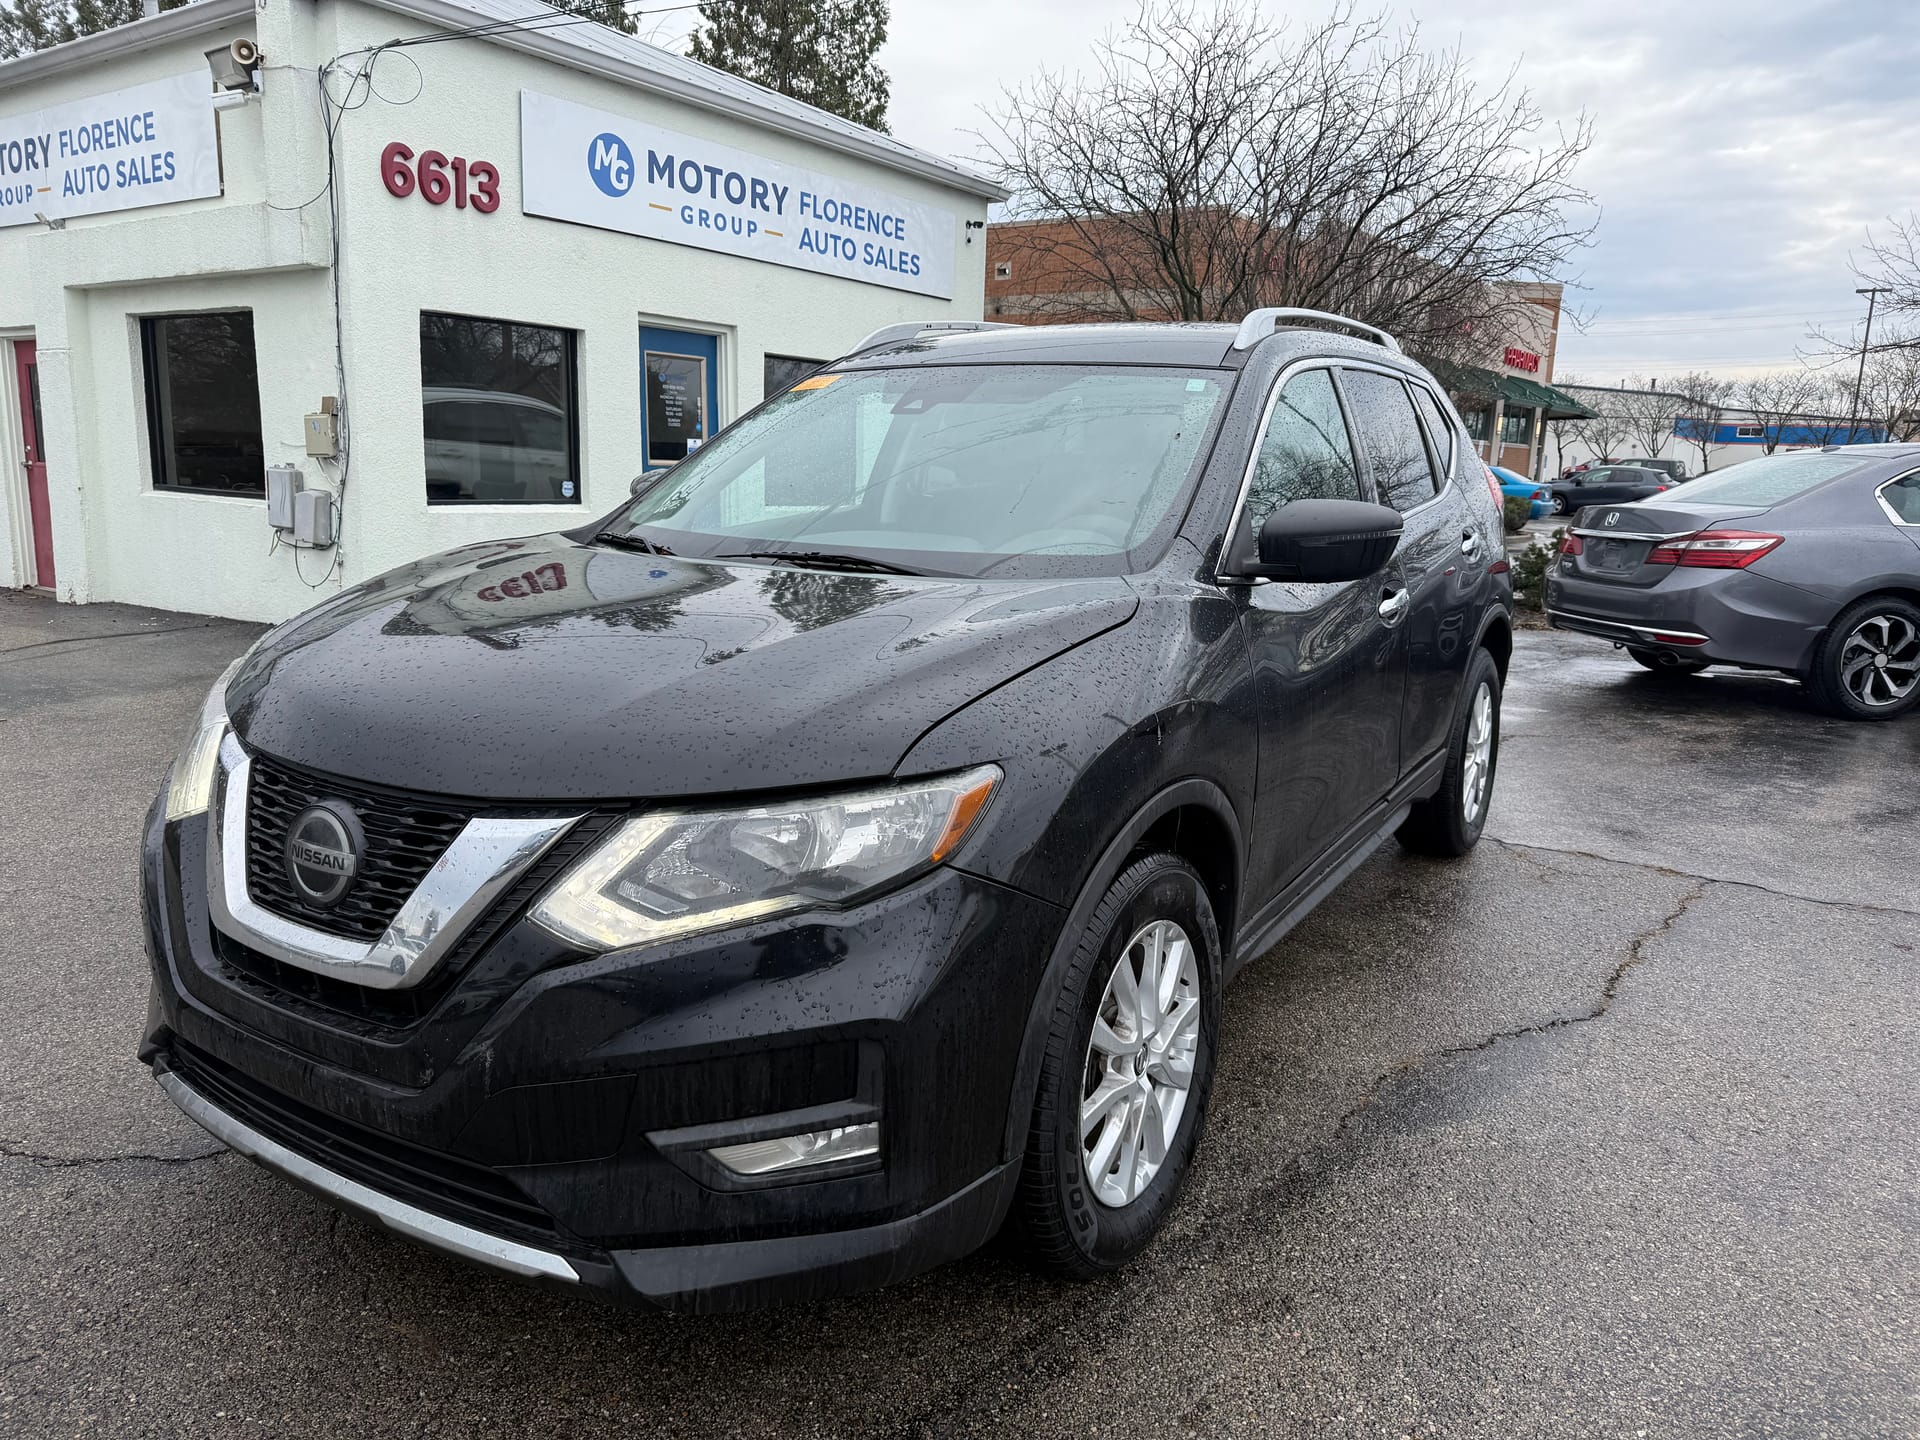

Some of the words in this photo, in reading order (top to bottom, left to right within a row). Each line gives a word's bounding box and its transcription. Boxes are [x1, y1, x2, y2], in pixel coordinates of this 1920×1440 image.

[59, 111, 156, 158] FLORENCE
[63, 163, 110, 197] AUTO
[116, 151, 176, 188] SALES
[380, 141, 500, 213] 6613
[594, 139, 630, 191] MG
[647, 149, 789, 216] MOTORY
[680, 205, 758, 237] GROUP
[799, 191, 906, 241] FLORENCE
[799, 227, 857, 261] AUTO
[863, 242, 921, 276] SALES
[291, 843, 345, 871] NISSAN
